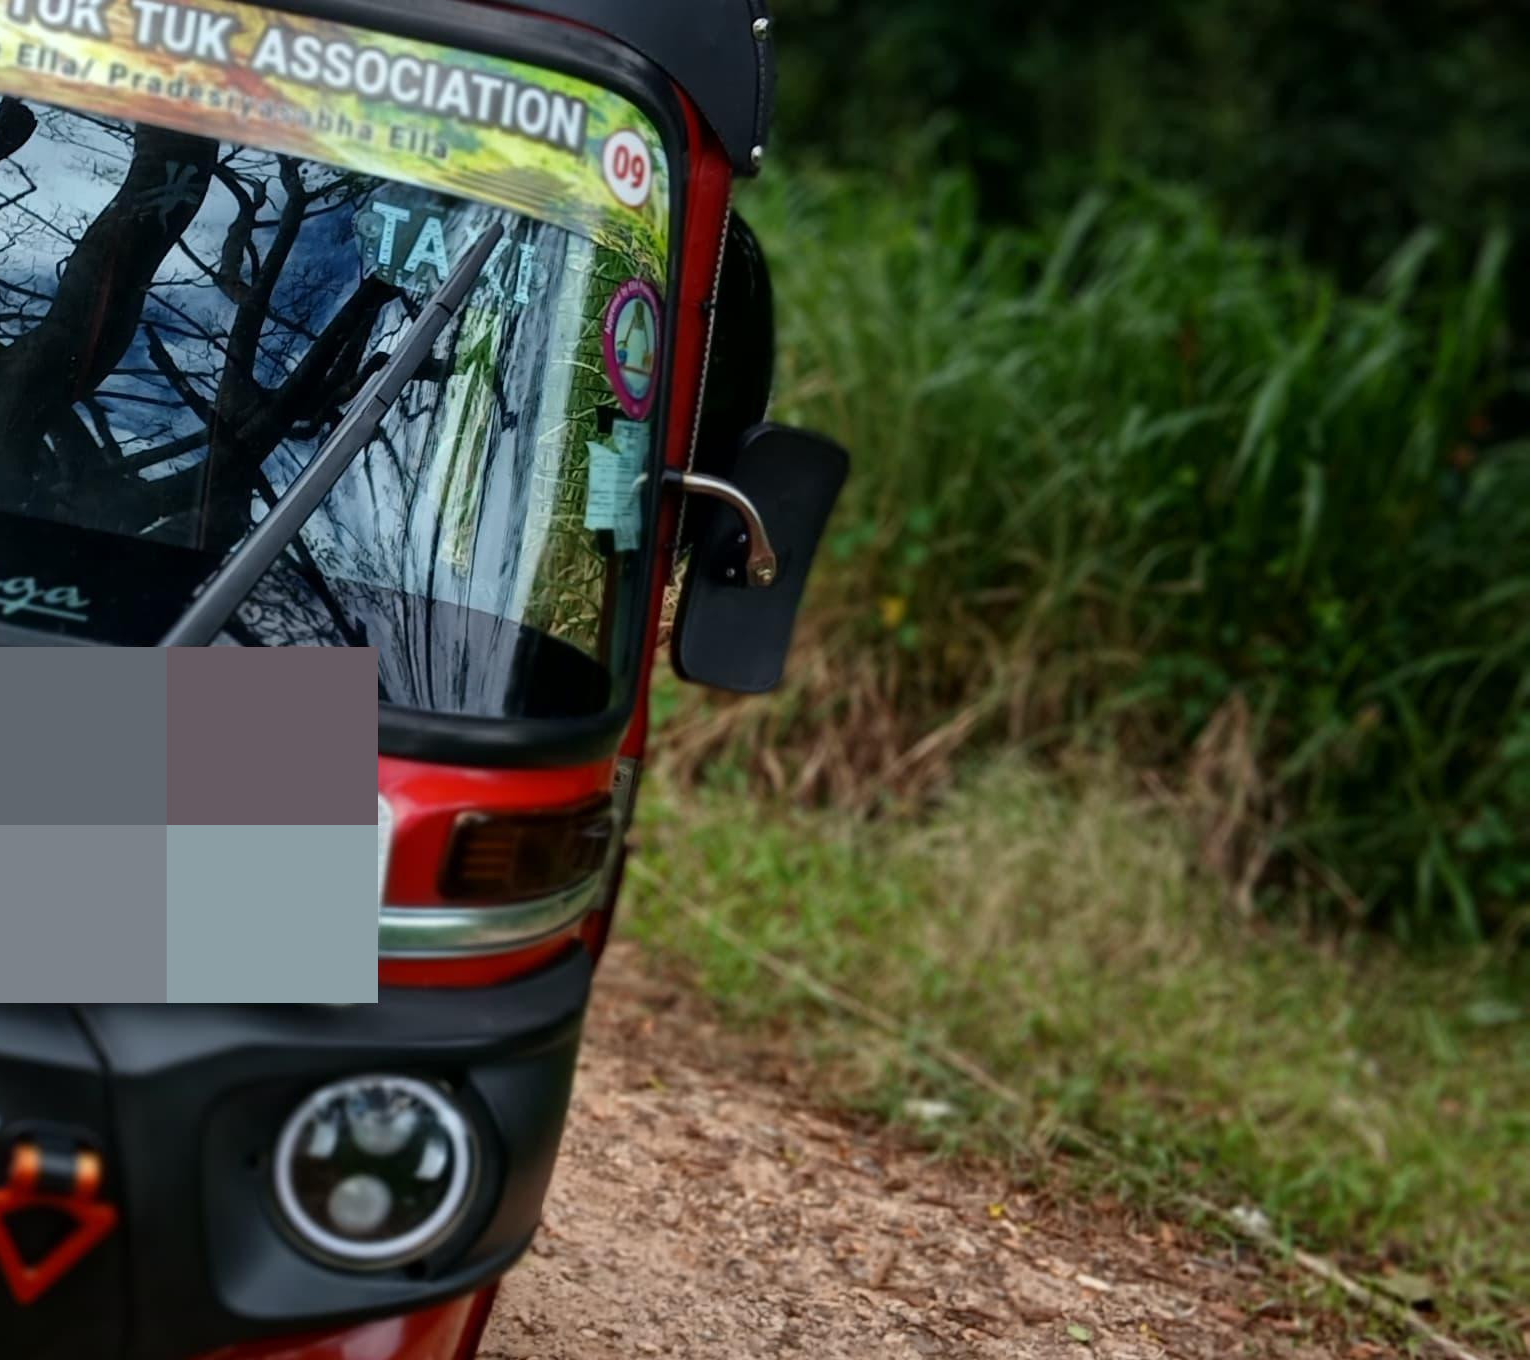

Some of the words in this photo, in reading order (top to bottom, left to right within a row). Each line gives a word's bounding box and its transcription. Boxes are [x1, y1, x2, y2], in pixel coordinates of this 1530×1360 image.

[252, 28, 583, 148] ASSOCIATION
[387, 123, 450, 161] Ella
[612, 144, 647, 188] 09
